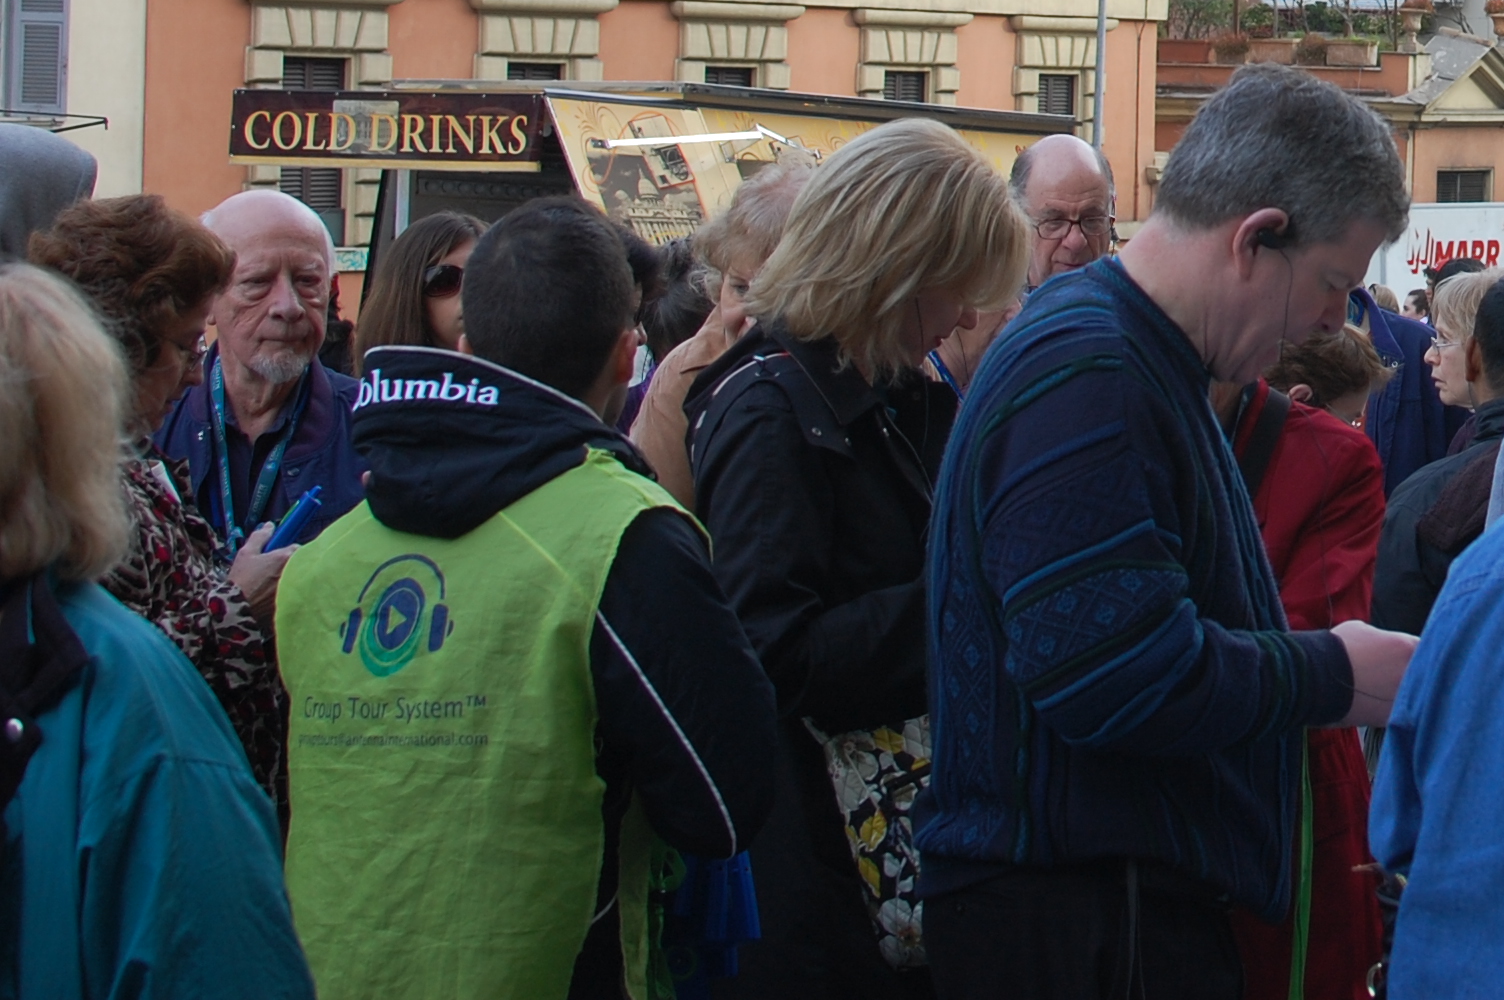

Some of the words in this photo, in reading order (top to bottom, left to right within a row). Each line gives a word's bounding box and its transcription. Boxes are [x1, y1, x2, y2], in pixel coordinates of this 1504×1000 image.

[244, 110, 357, 151] COLD
[369, 113, 529, 155] DRINKS
[352, 368, 500, 412] olumbia
[304, 695, 342, 724] Group
[347, 696, 389, 719] Tour
